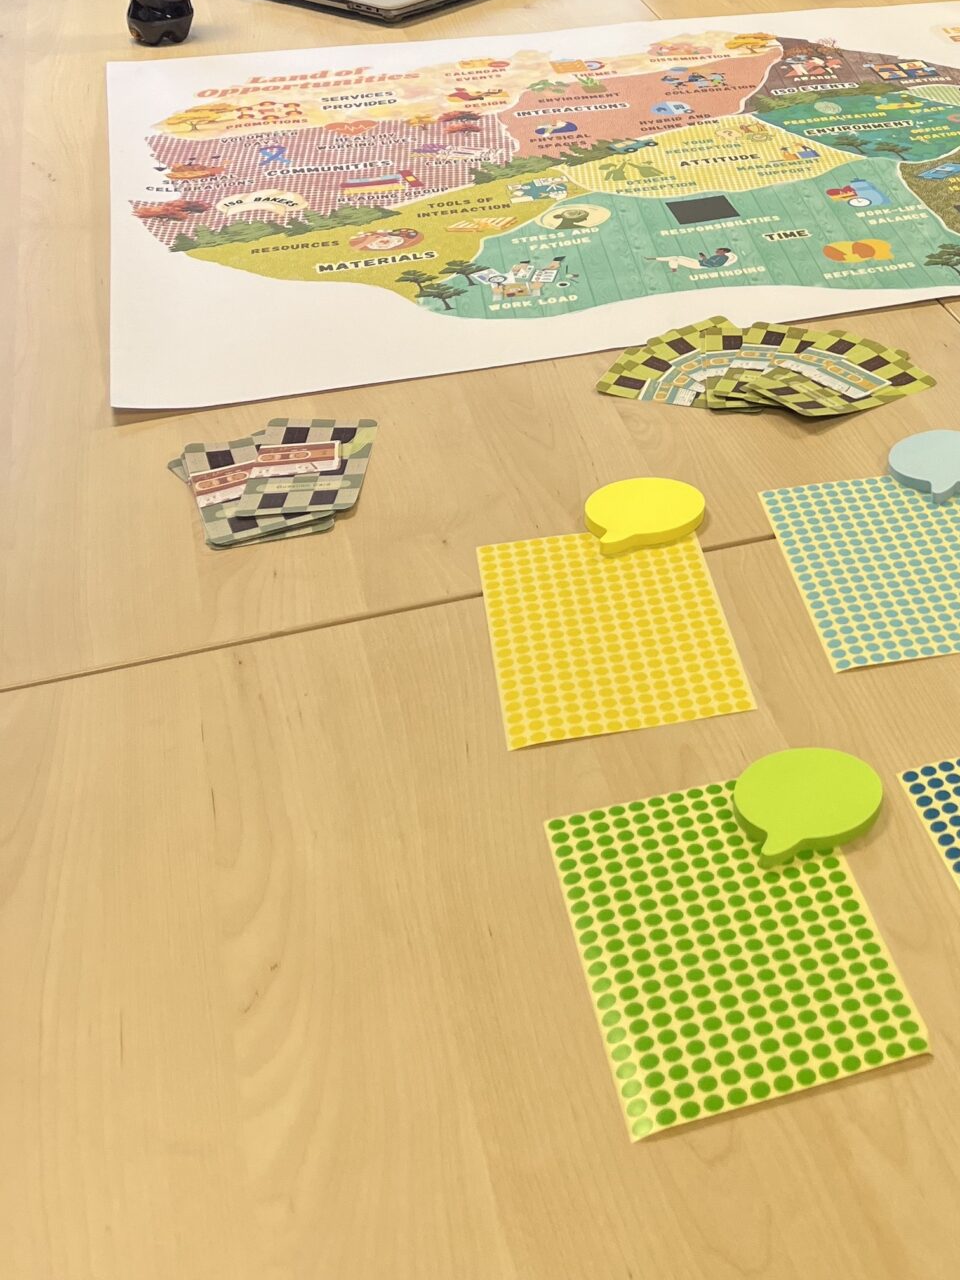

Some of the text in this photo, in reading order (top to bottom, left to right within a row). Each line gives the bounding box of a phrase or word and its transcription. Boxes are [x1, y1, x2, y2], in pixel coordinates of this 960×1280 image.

[650, 54, 731, 63] DISSEMINATION
[250, 66, 370, 83] Land of
[445, 69, 506, 78] CALENDAR
[455, 74, 502, 83] EVENTS
[572, 70, 618, 78] THEMES
[794, 74, 838, 83] AWARDS
[196, 73, 420, 98] Opportunities
[900, 76, 952, 85] MEETINGS
[665, 84, 756, 96] COLLABORATION
[772, 83, 858, 97] ISG EVENTS
[321, 91, 394, 103] SERVICES
[538, 92, 621, 104] ENVIRONMENT
[322, 99, 398, 111] PROVIDED
[464, 100, 507, 109] DESIGN
[516, 102, 628, 118] INTERACTIONS
[226, 119, 308, 130] PROMOTIONS
[639, 113, 711, 126] HYBRID AND
[640, 118, 720, 132] ONLINE WORK
[783, 112, 887, 126] PERSONALIZATION
[805, 120, 913, 136] ENVIRONMENT
[221, 130, 298, 144] VOLUNTEER
[335, 133, 395, 144] HEALTHY
[529, 133, 591, 144] PHYSICAL
[682, 138, 714, 147] YOUR
[244, 140, 279, 149] DAYS
[317, 137, 418, 151] WORKING LIVES
[537, 140, 588, 149] SPACES
[665, 142, 743, 155] PERCEPTION
[426, 156, 491, 167] CRAFTING
[680, 153, 760, 167] ATTITUDE
[736, 158, 820, 172] MANAGEMENT
[267, 160, 391, 177] COMMUNITIES
[757, 166, 813, 178] SUPPORT
[146, 179, 255, 193] CELEBRATIONS
[162, 174, 236, 186] SEASONAL
[626, 175, 677, 186] OTHERS
[615, 181, 697, 195] PERCEPTION
[337, 187, 449, 203] READING GROUP
[223, 196, 299, 209] ISG BAKERS
[427, 197, 494, 209] TOOLS OF
[417, 203, 511, 218] INTERACTION
[868, 212, 929, 226] BALANCE
[660, 215, 780, 237] RESPONSIBILITIES
[511, 227, 600, 245] STRESS AND
[764, 229, 809, 242] TIME
[250, 240, 341, 255] RESOURCES
[529, 237, 592, 252] FATIGUE
[318, 252, 436, 273] MATERIALS
[688, 265, 766, 282] UNWINDING
[823, 261, 915, 280] REFLECTIONS
[488, 294, 579, 313] WORK LOAD
